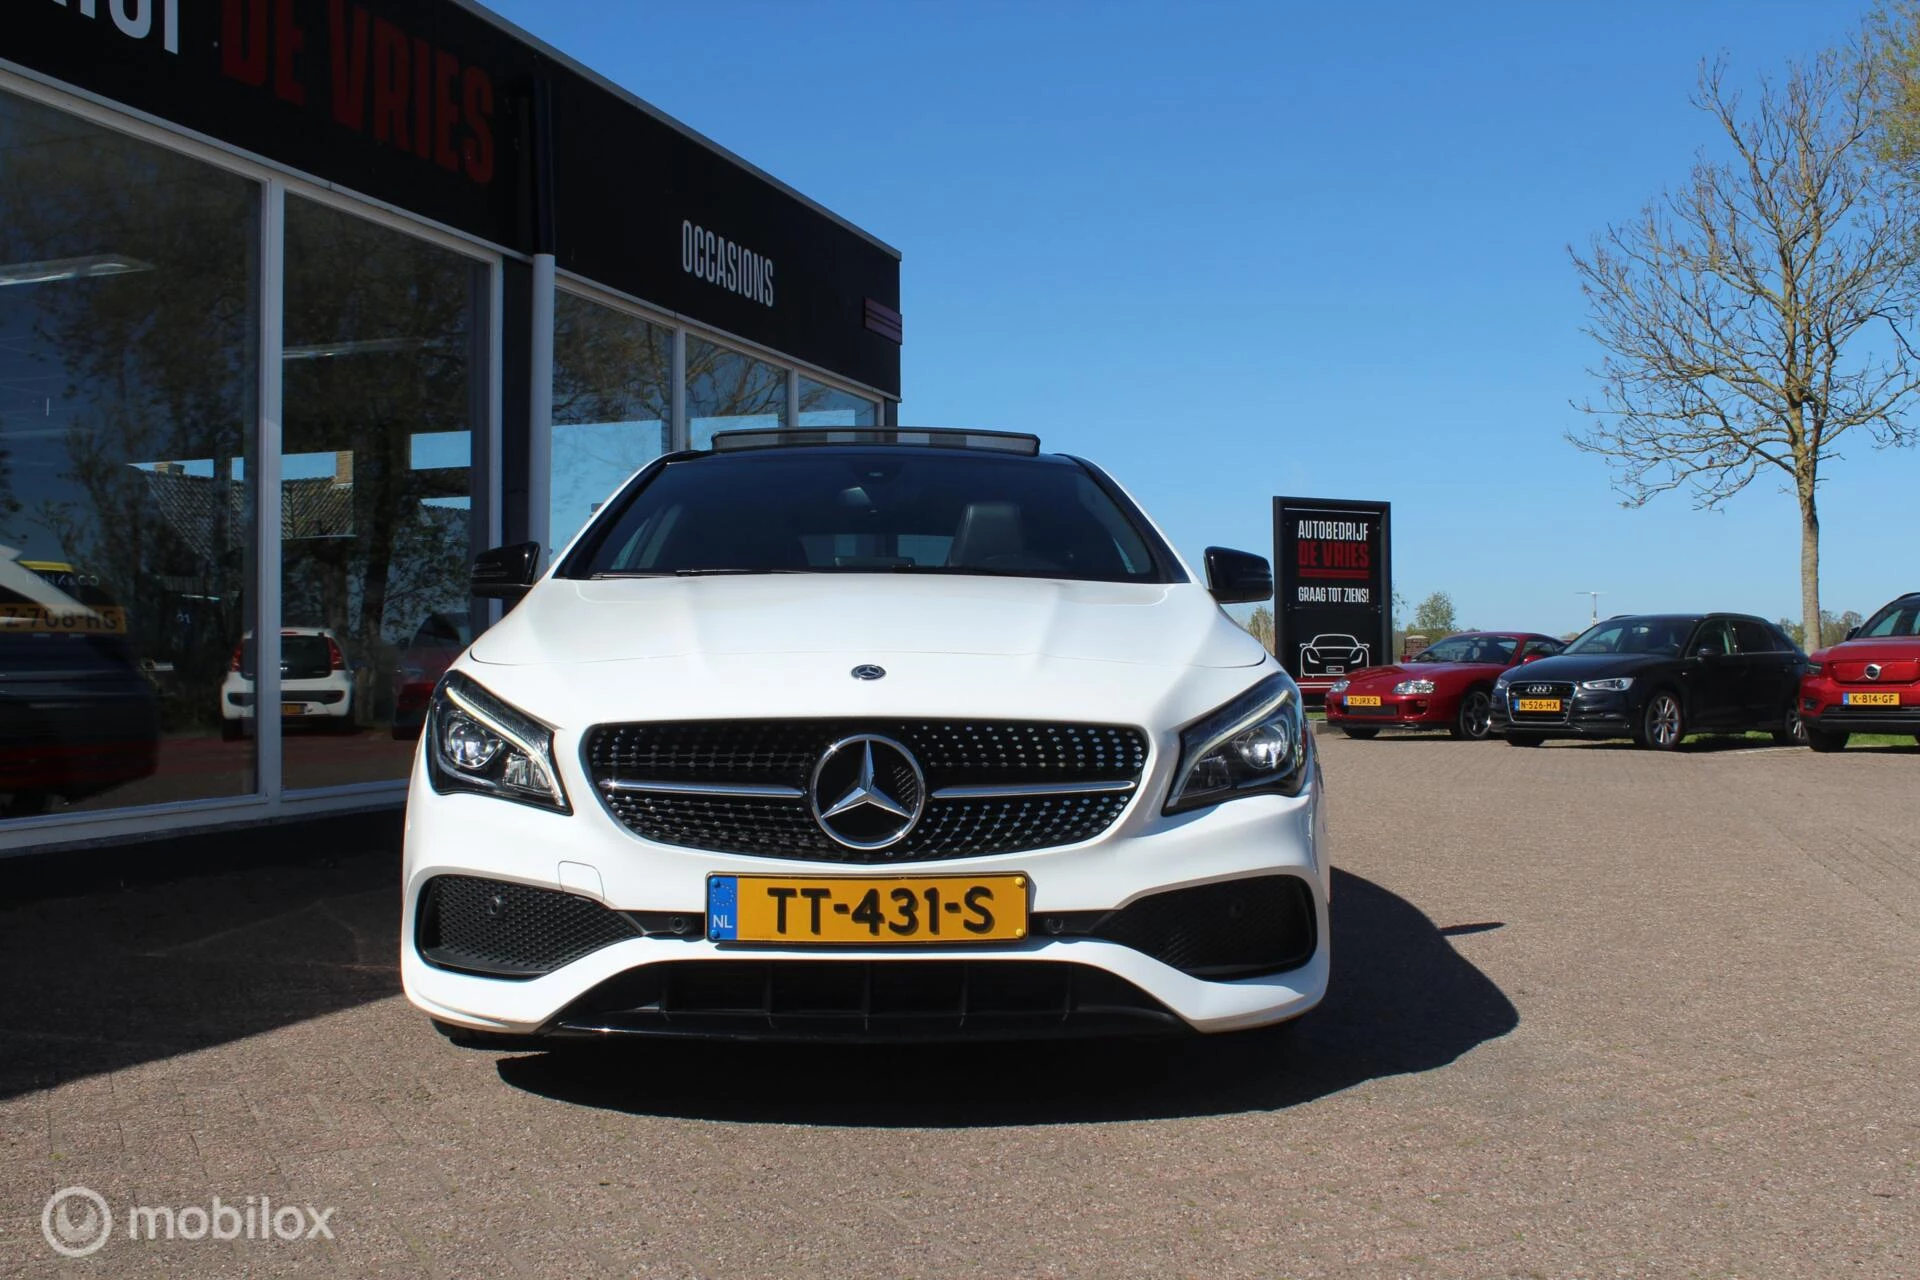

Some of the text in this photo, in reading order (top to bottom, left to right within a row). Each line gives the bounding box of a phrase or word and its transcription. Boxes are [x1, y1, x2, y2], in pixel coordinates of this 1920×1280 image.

[327, 0, 495, 186] VRIES
[682, 219, 774, 307] OCCASIONS
[1297, 519, 1369, 541] AUTOBEDRIJF
[1297, 540, 1370, 569] DE VRIES
[1298, 585, 1370, 604] GRAAG TOT ZIENS!
[1520, 700, 1558, 710] N-526-HX
[1852, 694, 1895, 704] K-814-GF
[713, 886, 996, 936] NL TT-431-S
